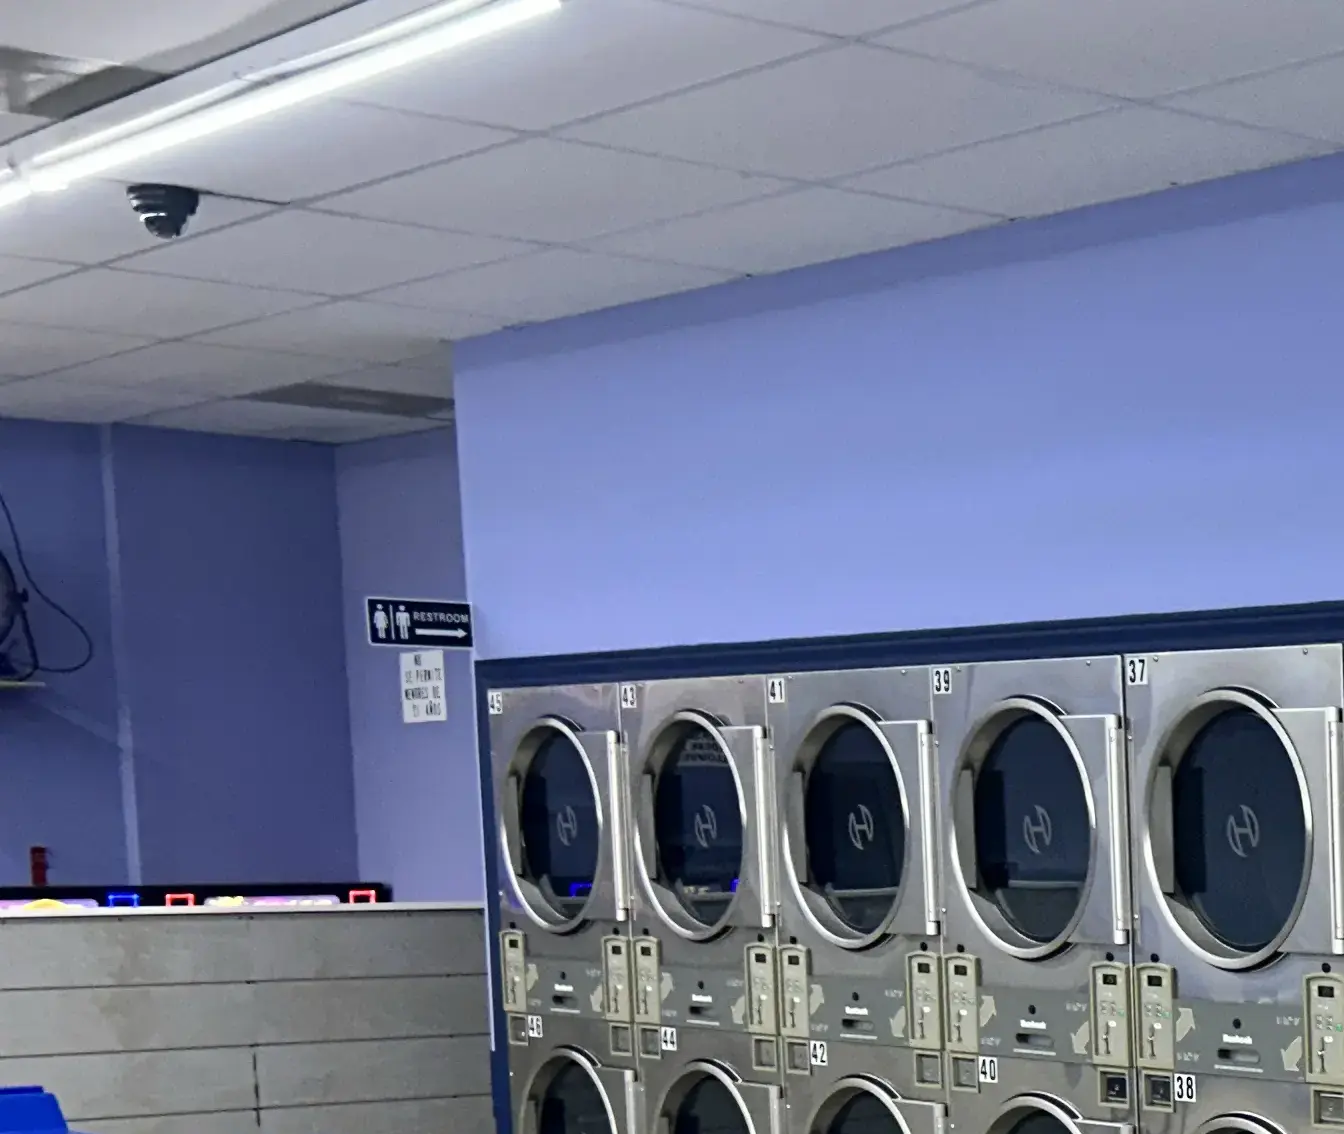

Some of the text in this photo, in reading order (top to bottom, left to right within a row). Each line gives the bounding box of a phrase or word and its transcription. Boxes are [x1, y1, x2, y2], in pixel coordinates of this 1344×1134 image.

[413, 611, 469, 624] RESTROOM
[934, 669, 950, 693] 39
[1128, 659, 1147, 683] 37
[622, 685, 636, 707] 43
[769, 681, 784, 702] 41
[490, 692, 501, 714] 45
[663, 1027, 676, 1048] 44
[811, 1043, 827, 1064] 42
[980, 1058, 996, 1081] 40
[1176, 1075, 1195, 1100] 38
